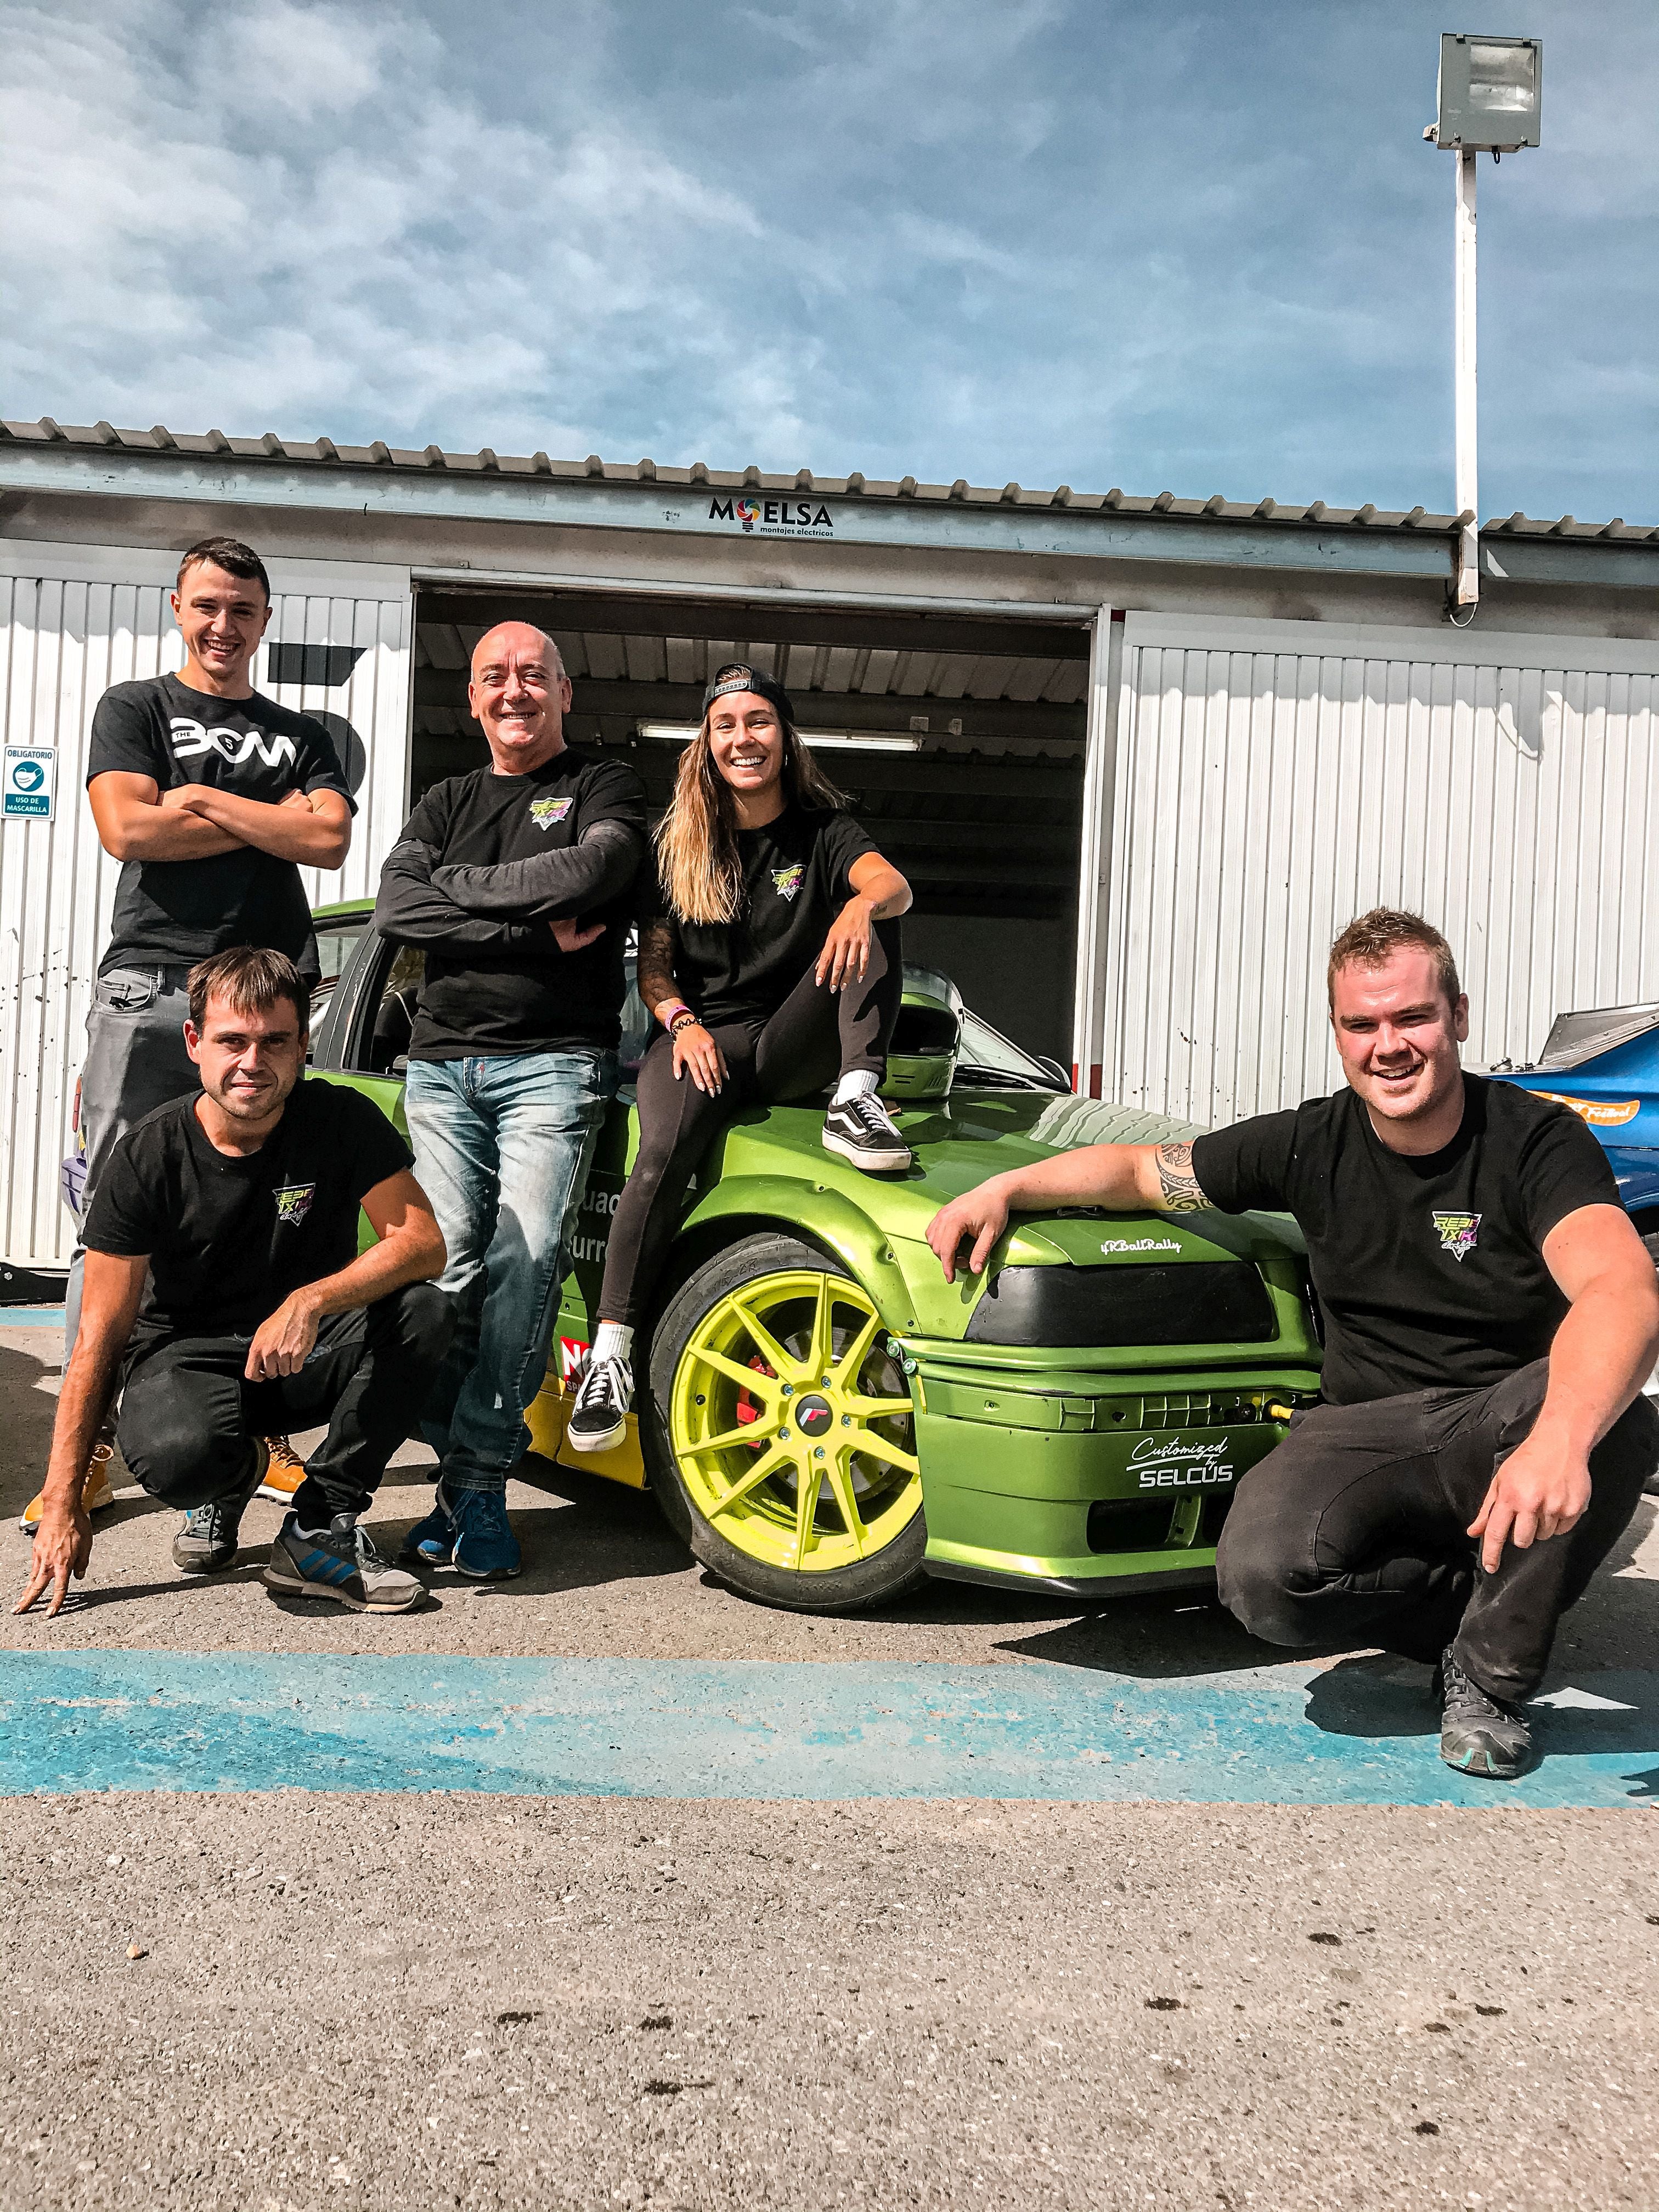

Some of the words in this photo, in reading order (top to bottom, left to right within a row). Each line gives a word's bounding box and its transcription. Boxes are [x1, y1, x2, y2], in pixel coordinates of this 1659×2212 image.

[7, 749, 53, 759] OBLIGATORIO
[7, 805, 47, 813] MASCARILLA
[567, 1380, 582, 1392] SP
[1131, 1436, 1228, 1460] Customized
[1205, 1455, 1217, 1470] by
[1139, 1465, 1233, 1488] SELCUS
